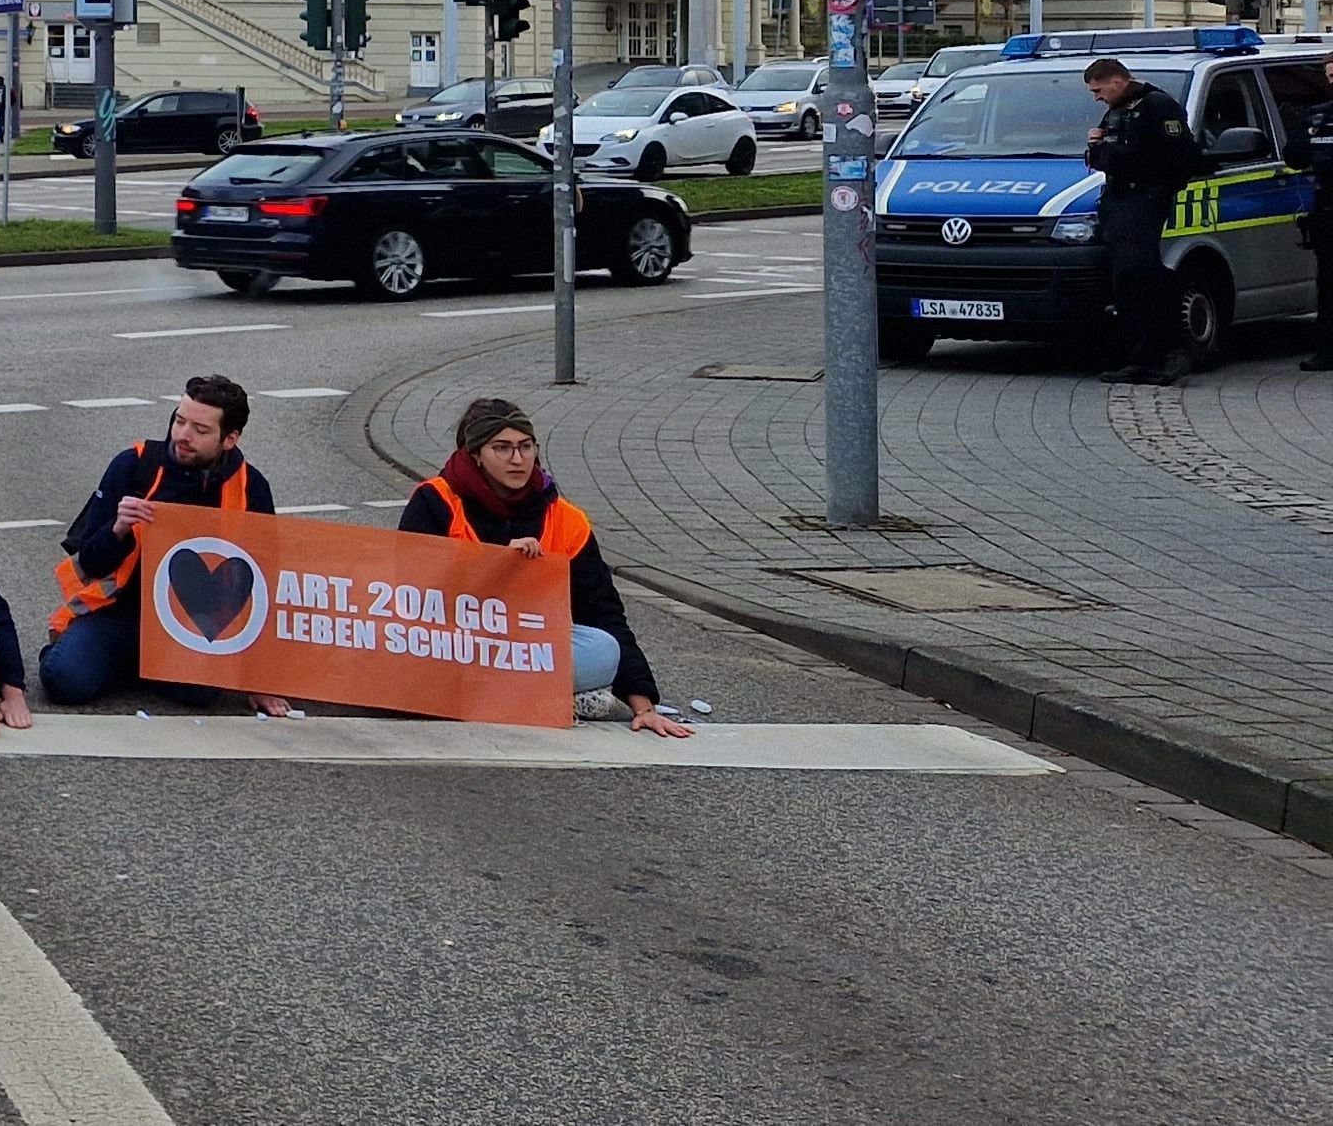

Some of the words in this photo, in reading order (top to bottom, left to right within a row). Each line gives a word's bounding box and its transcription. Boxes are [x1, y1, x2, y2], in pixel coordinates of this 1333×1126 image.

[908, 180, 1047, 195] POLIZEI
[920, 302, 946, 315] LSA
[959, 303, 1001, 317] 47835
[275, 570, 358, 613] ART.
[367, 581, 446, 624] 20A
[455, 593, 508, 634] GG
[276, 610, 376, 650] LEBEN
[384, 622, 555, 672] SCHÜTZEN
